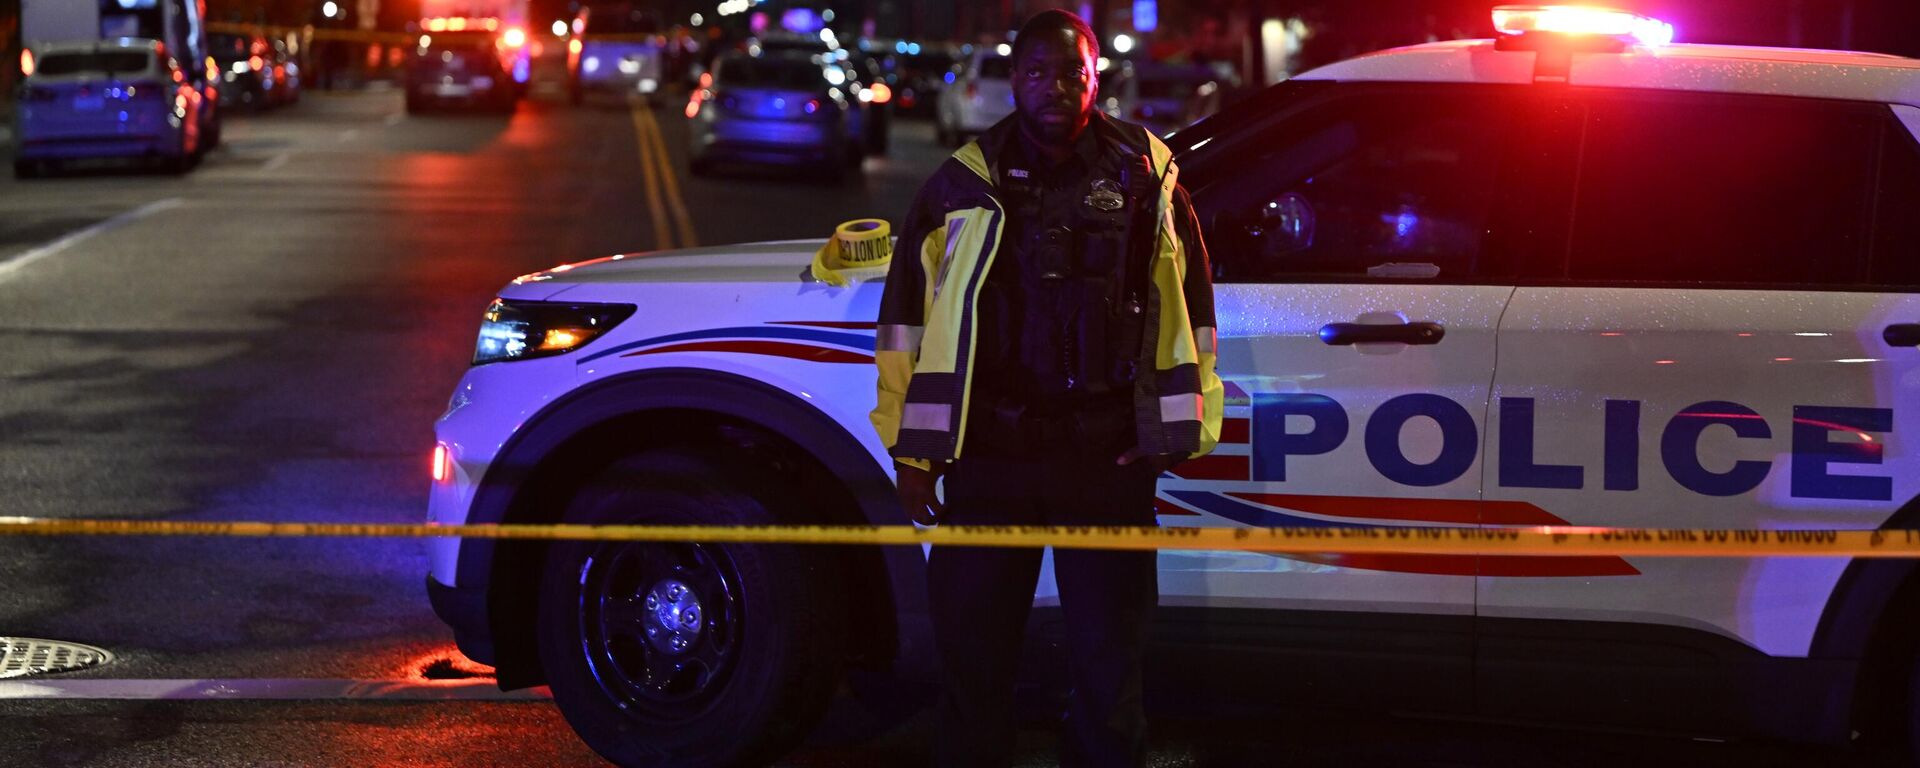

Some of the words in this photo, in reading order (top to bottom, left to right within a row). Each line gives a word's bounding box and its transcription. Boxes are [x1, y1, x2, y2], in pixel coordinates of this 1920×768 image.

[1007, 168, 1029, 178] POLICE
[854, 240, 874, 262] NOT
[1252, 392, 1892, 500] POLICE
